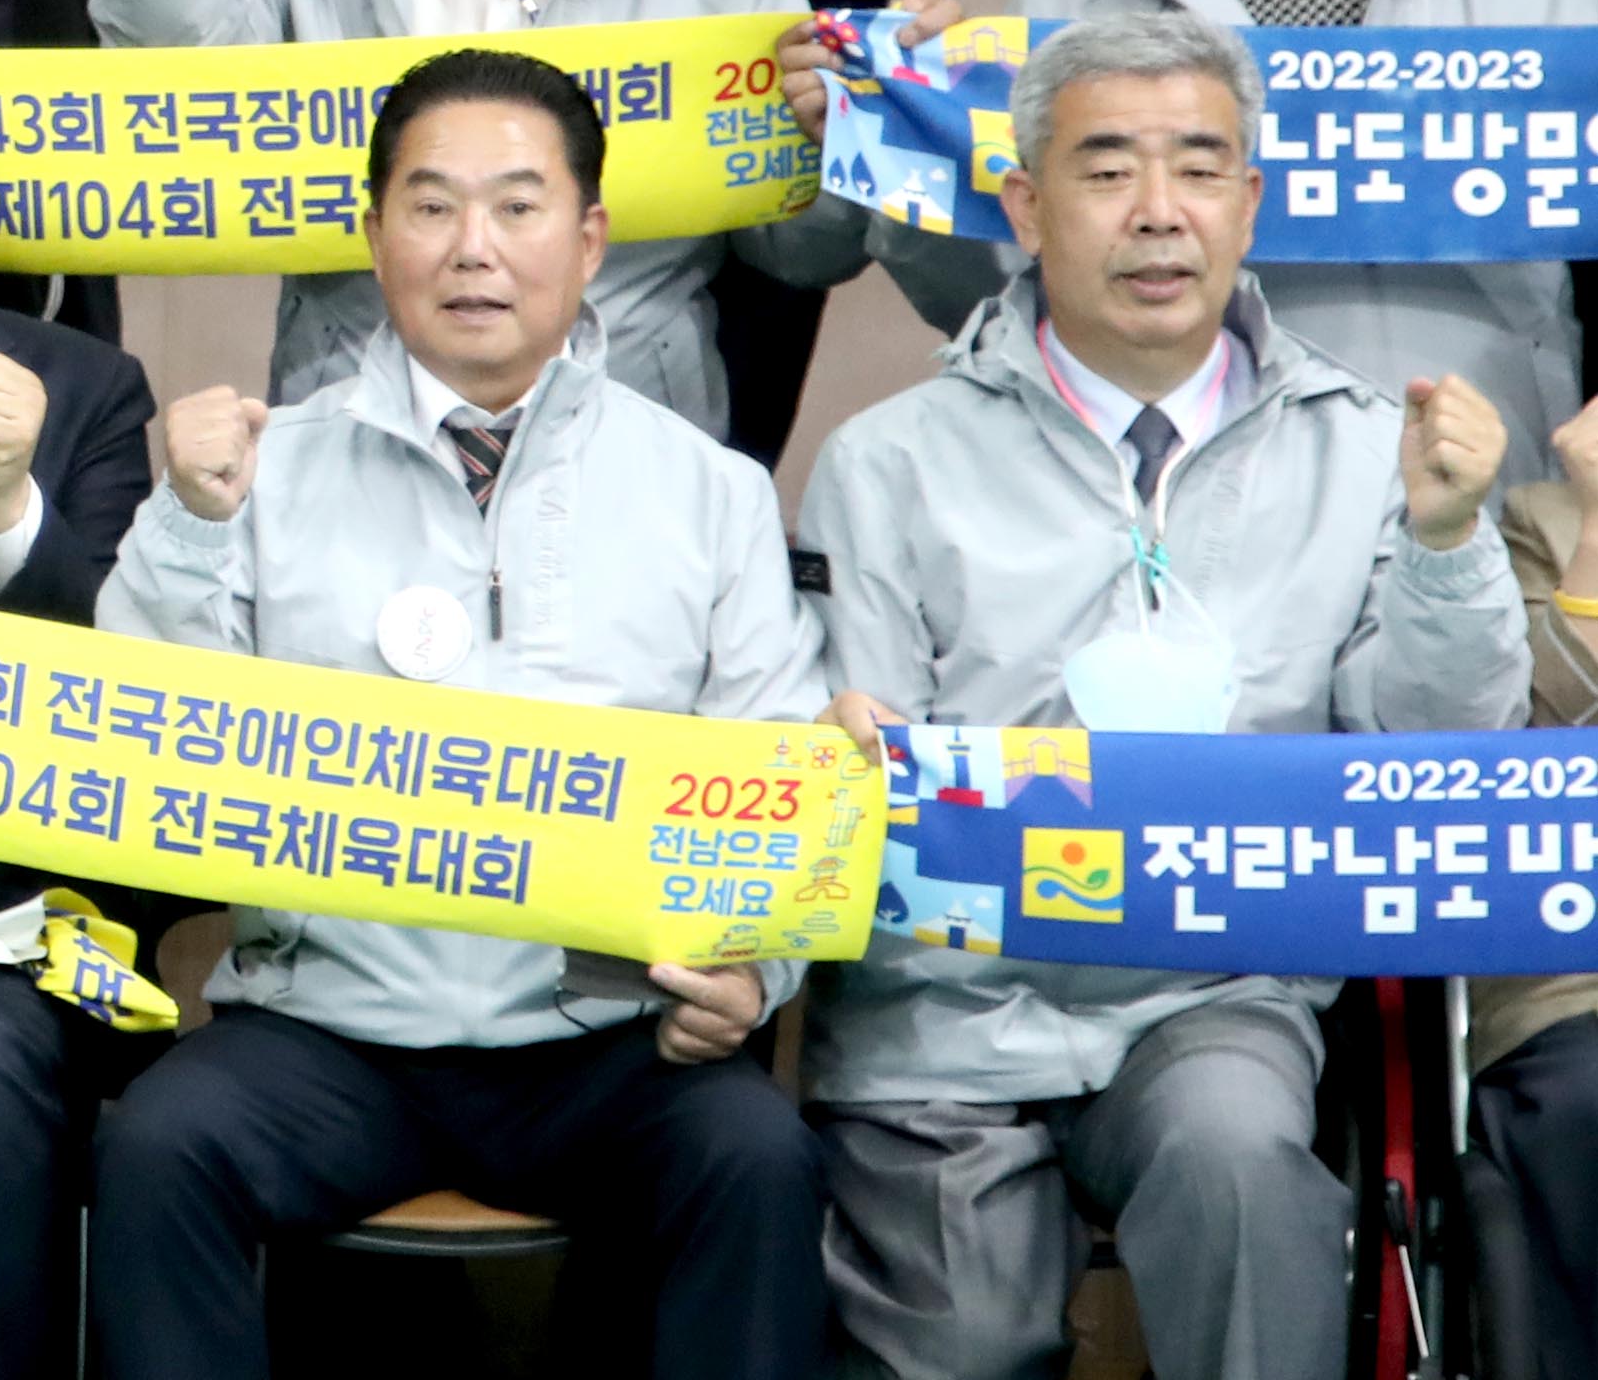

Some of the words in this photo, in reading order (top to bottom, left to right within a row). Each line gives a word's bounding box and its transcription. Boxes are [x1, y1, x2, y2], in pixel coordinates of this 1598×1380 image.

[1269, 50, 1544, 91] 2022-2023
[47, 672, 626, 822] 전국장애인체육대회
[665, 772, 803, 822] 2023
[1344, 757, 1598, 802] 2022-202
[150, 785, 533, 905] 전국체육대회
[649, 824, 799, 871] 전남으로
[660, 874, 774, 917] 오세요
[1143, 825, 1489, 934] 전라남도
